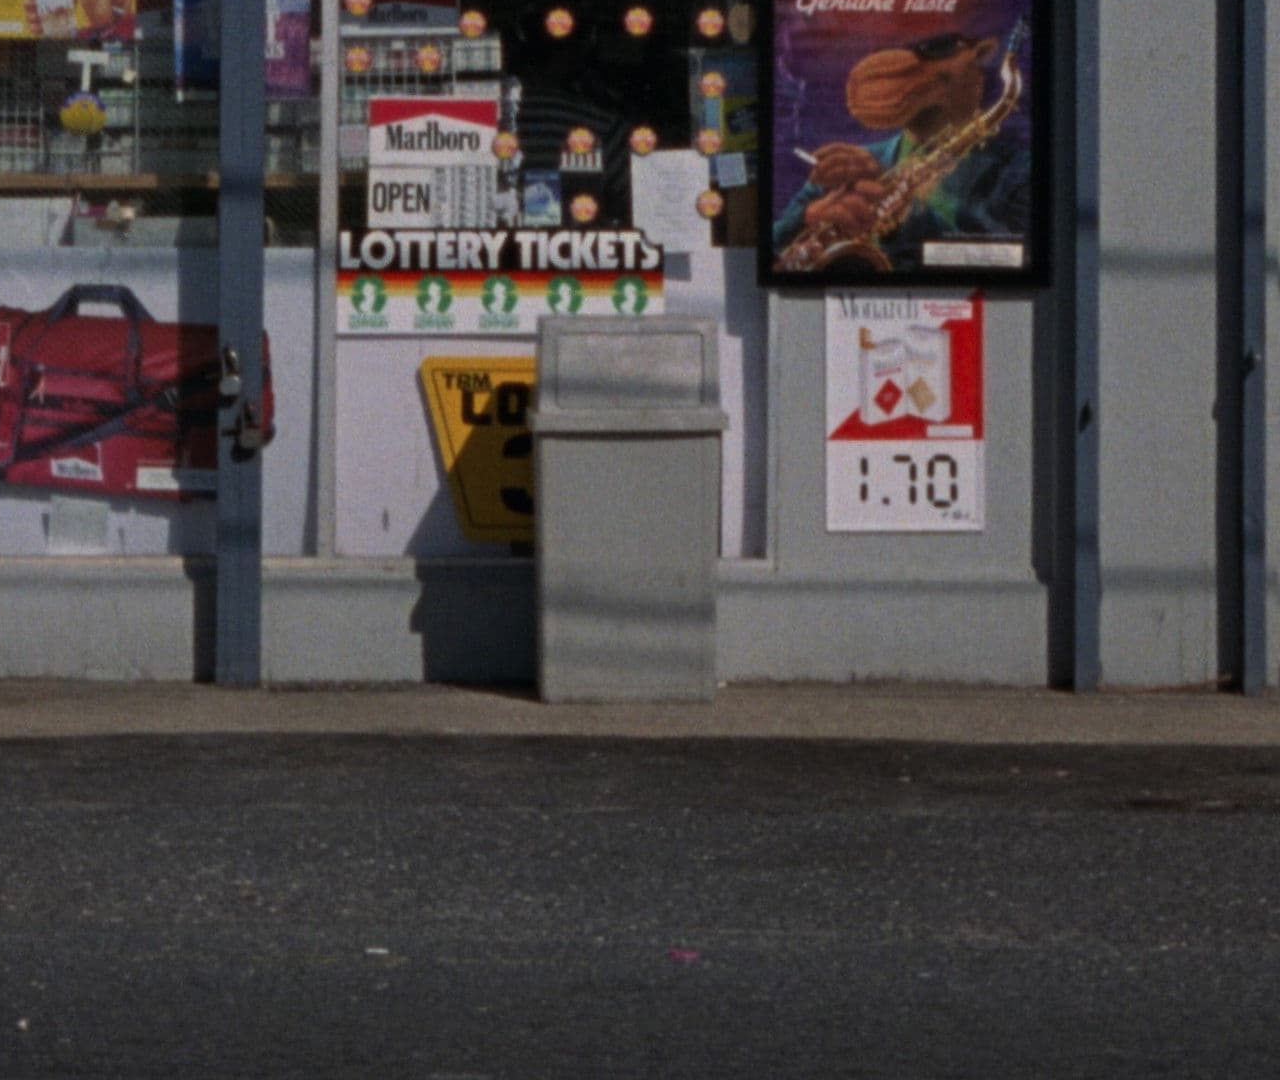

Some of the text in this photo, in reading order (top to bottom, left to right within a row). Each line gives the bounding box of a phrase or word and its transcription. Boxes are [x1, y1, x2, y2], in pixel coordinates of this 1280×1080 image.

[385, 121, 481, 151] Marlboro
[372, 182, 430, 213] OPEN
[339, 230, 661, 271] LOTTERY TICKETS
[860, 454, 957, 508] 1.70
